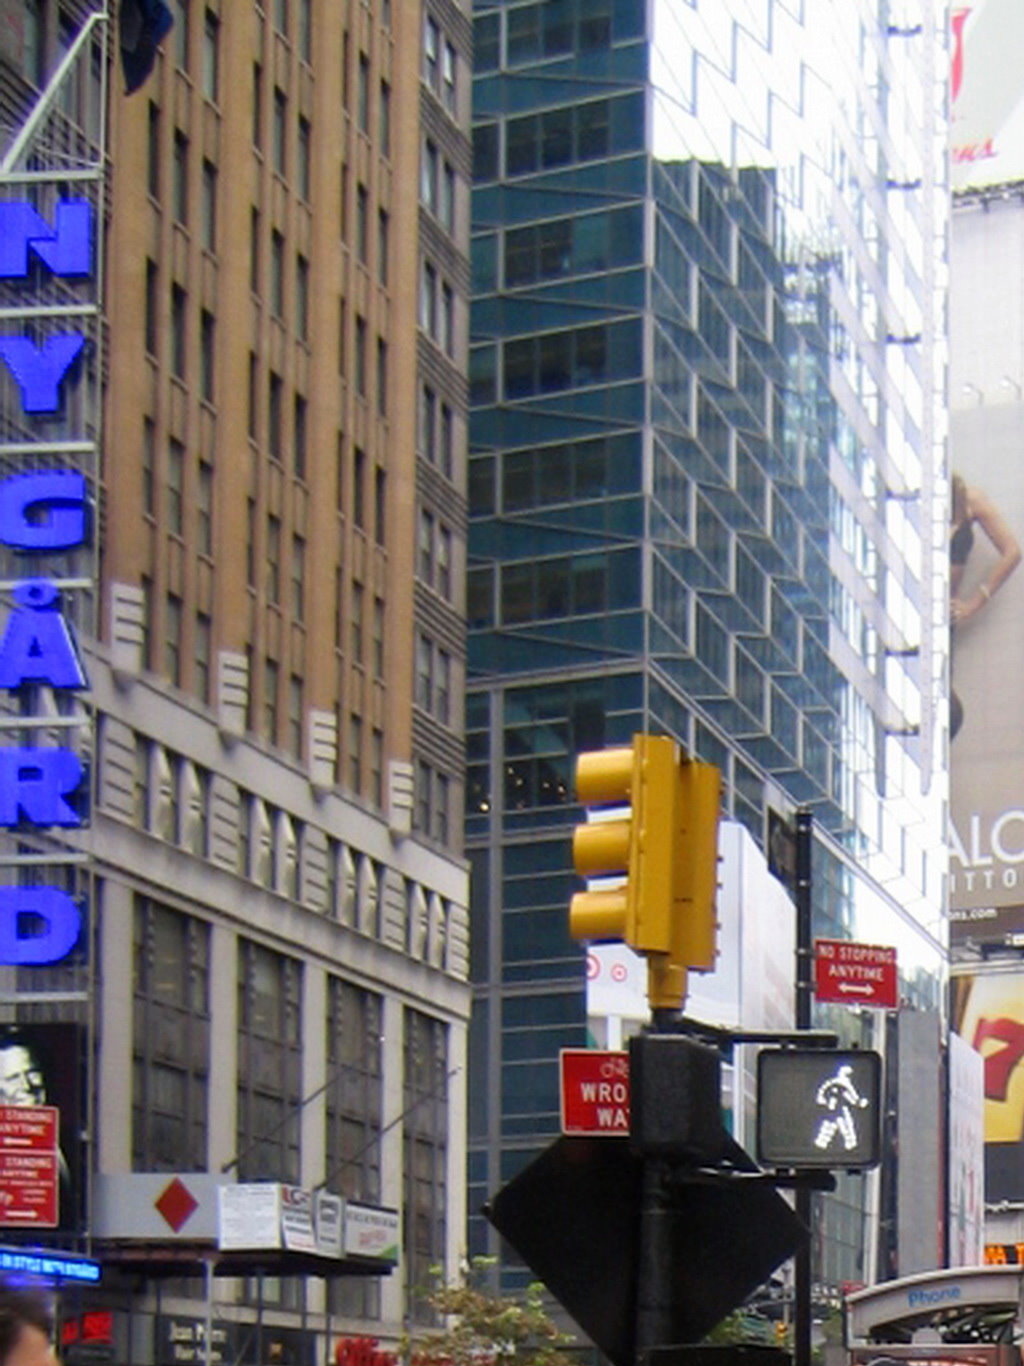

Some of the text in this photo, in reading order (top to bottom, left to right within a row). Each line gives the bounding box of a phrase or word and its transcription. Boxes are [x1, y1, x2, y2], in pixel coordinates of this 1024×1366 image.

[818, 945, 892, 964] NO STOPPING
[828, 964, 884, 982] ANYTIME
[581, 1082, 628, 1103] WRO
[596, 1107, 630, 1127] WA
[908, 1286, 960, 1307] Phone
